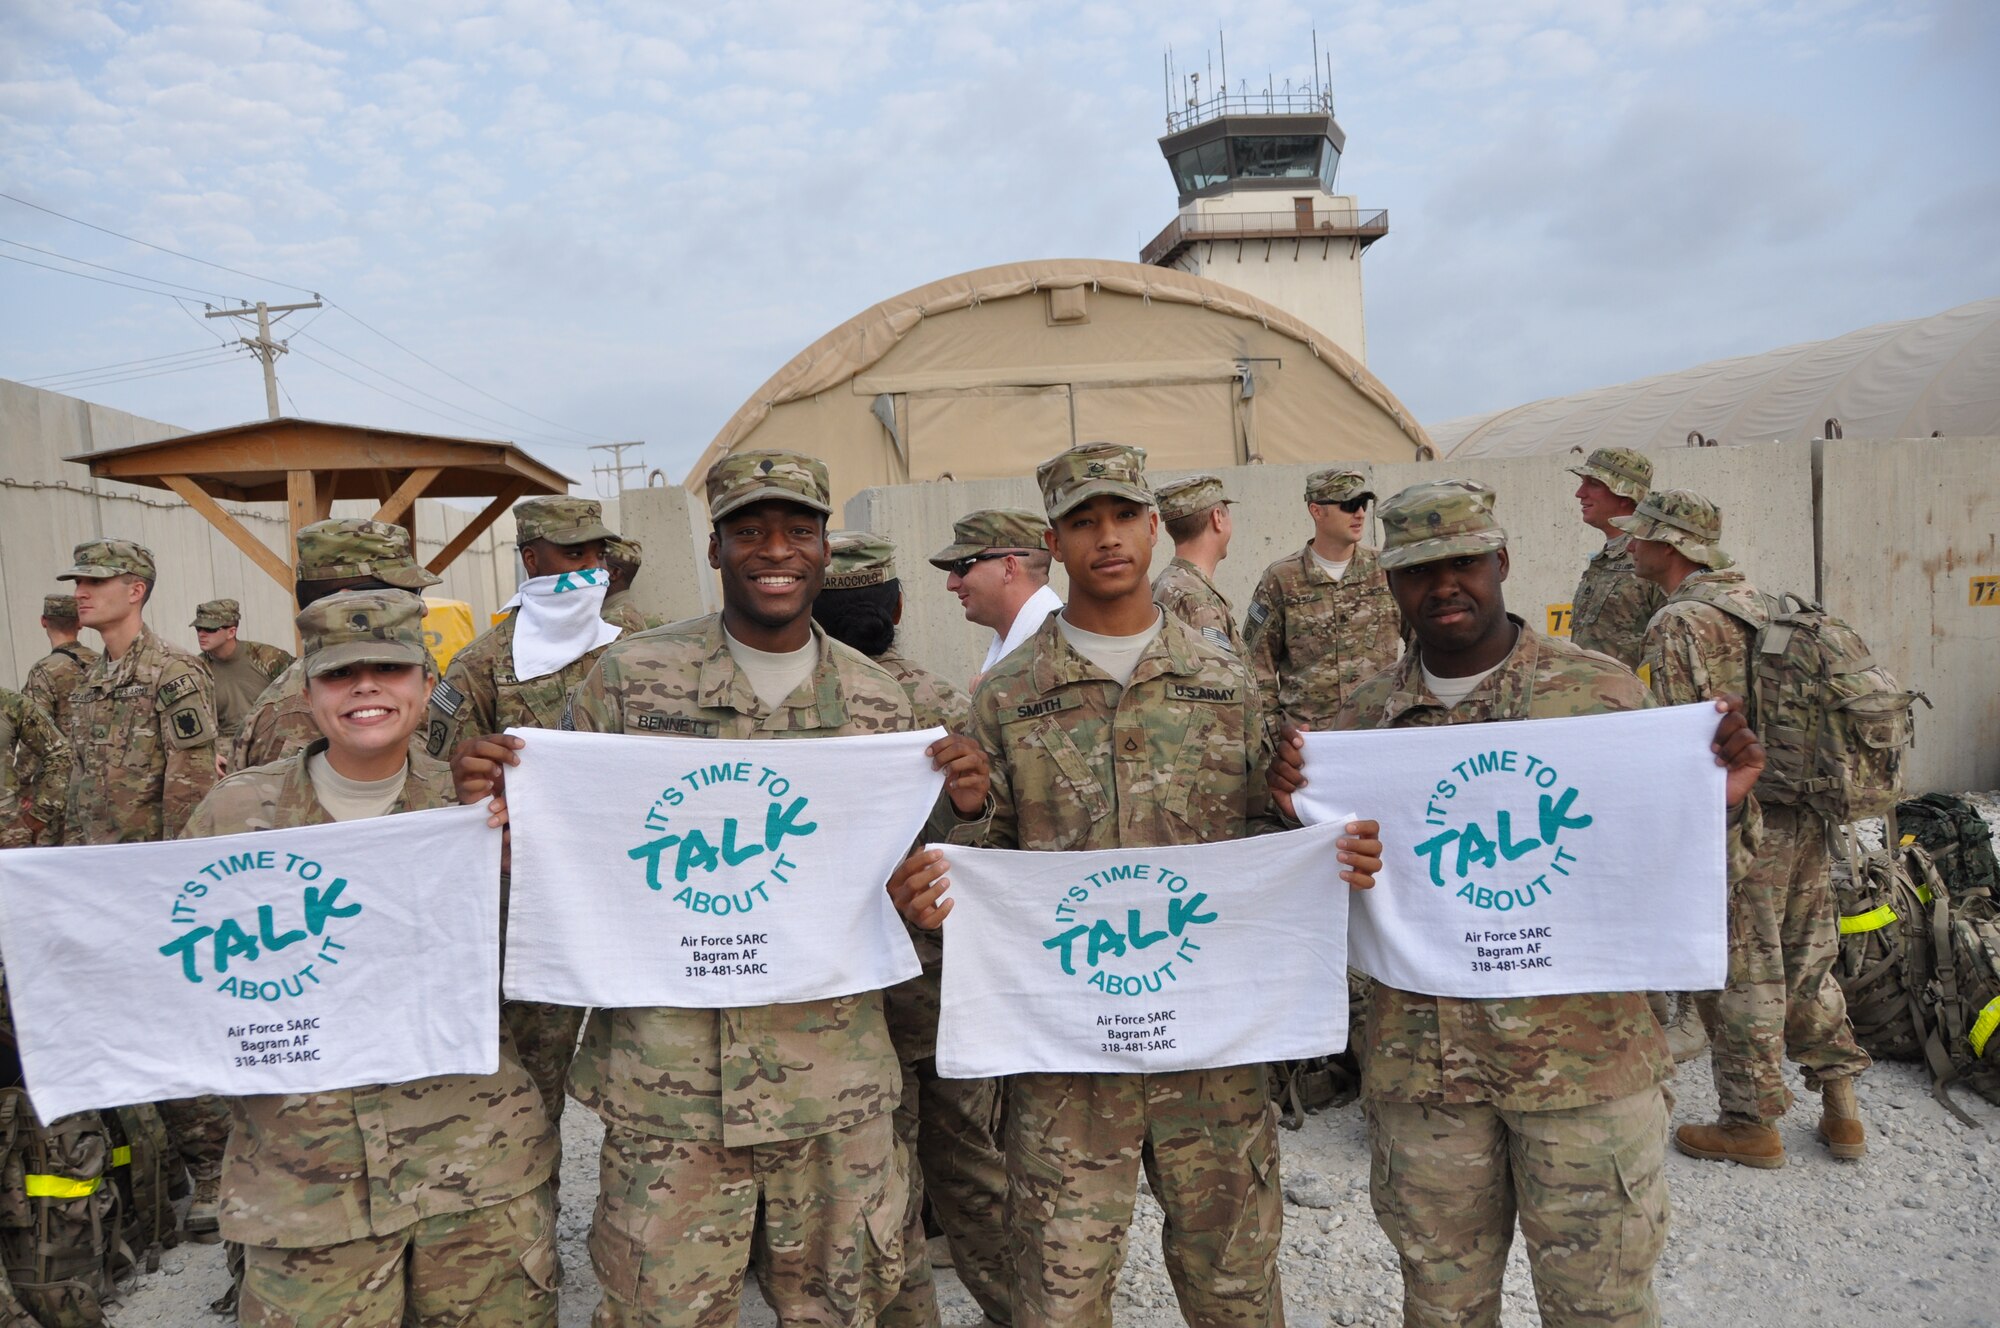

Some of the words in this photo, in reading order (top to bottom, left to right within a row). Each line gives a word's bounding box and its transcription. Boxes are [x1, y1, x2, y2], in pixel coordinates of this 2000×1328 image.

[822, 572, 878, 588] ARACCIOLO
[1199, 687, 1235, 701] ARMY
[1017, 698, 1062, 718] SMITH
[638, 714, 713, 735] BENNETT
[645, 787, 685, 832] IT'S
[681, 762, 752, 792] TIME
[757, 767, 790, 798] TO
[1425, 779, 1457, 826] IT'S
[1451, 750, 1518, 783] TIME
[1525, 754, 1558, 789] TO
[627, 796, 819, 891] TALK
[1413, 786, 1594, 888] TALK
[171, 880, 208, 923] IT'S
[199, 851, 276, 881] TIME
[285, 853, 323, 881] TO
[673, 880, 769, 916] ABOUT
[770, 852, 797, 884] IT
[1456, 874, 1552, 912] ABOUT
[1550, 845, 1577, 876] IT
[1055, 886, 1089, 923] IT'S
[1085, 864, 1151, 889] TIME
[1157, 867, 1188, 893] TO
[159, 877, 363, 983] TALK
[680, 936, 698, 947] Air
[701, 935, 733, 946] Force
[736, 933, 768, 945] SARC
[1042, 892, 1219, 976] TALK
[1464, 932, 1482, 943] Air
[1484, 931, 1517, 942] Force
[1519, 927, 1552, 939] SARC
[693, 951, 739, 964] Bagram
[742, 948, 757, 960] AF
[1477, 946, 1524, 960] Bagram
[1526, 942, 1542, 954] AF
[217, 964, 320, 1002] ABOUT
[317, 936, 346, 964] IT
[685, 963, 768, 977] 318-481-SARC
[1087, 961, 1177, 997] ABOUT
[1176, 937, 1201, 964] IT
[1471, 956, 1552, 972] 318-481-SARC
[227, 1026, 246, 1037] Air
[249, 1023, 284, 1035] Force
[286, 1017, 320, 1031] SARC
[1096, 1015, 1113, 1026] Air
[1115, 1014, 1145, 1025] Force
[1147, 1010, 1176, 1024] SARC
[1107, 1029, 1150, 1041] Bagram
[1152, 1025, 1167, 1037] AF
[240, 1040, 290, 1053] Bagram
[292, 1034, 309, 1047] AF
[1101, 1038, 1176, 1053] 318-481-SARC
[234, 1049, 320, 1067] 318-481-SARC
